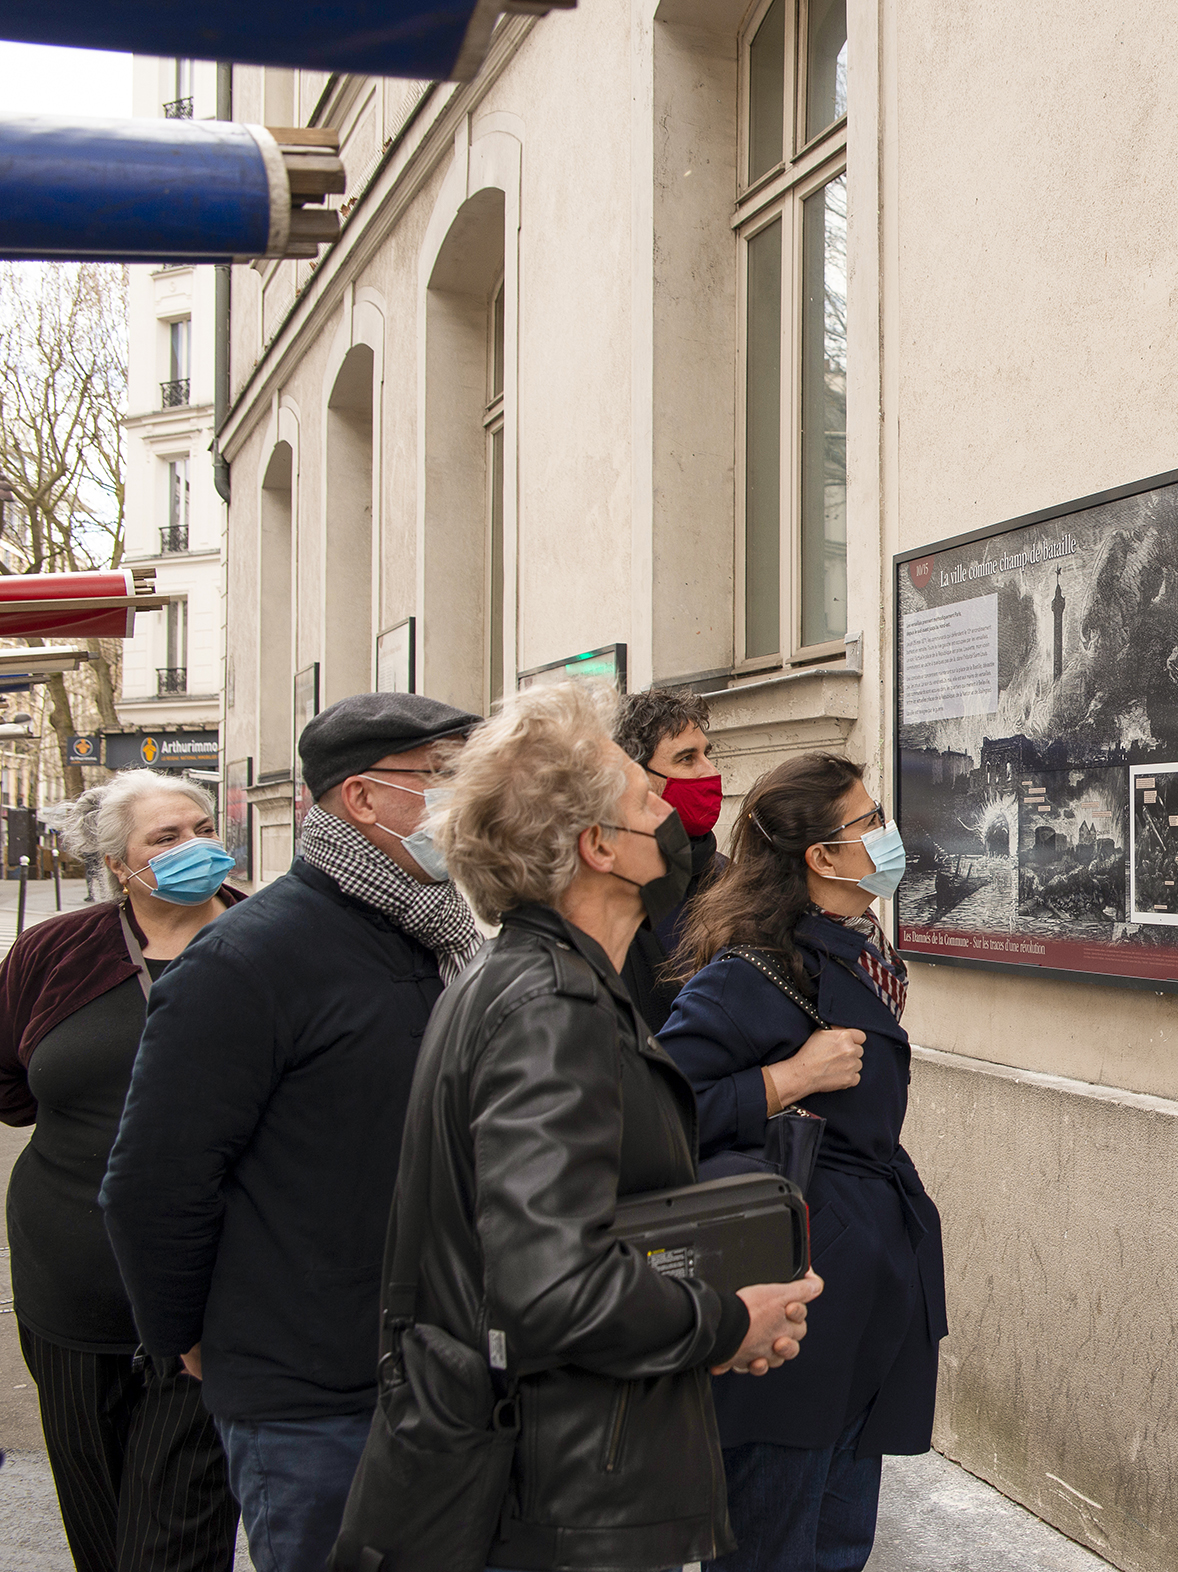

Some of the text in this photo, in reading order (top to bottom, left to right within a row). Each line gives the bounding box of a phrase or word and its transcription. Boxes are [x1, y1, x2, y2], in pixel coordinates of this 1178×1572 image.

[916, 563, 928, 577] 10/15
[940, 533, 1077, 587] La ville comme champ de bataille
[912, 931, 931, 944] Damnés
[932, 932, 938, 944] de
[939, 933, 944, 945] la
[944, 934, 969, 947] Commune
[973, 936, 982, 948] Sur
[990, 940, 1004, 951] traces
[1005, 938, 1019, 952] d'une
[1020, 940, 1045, 954] révolution
